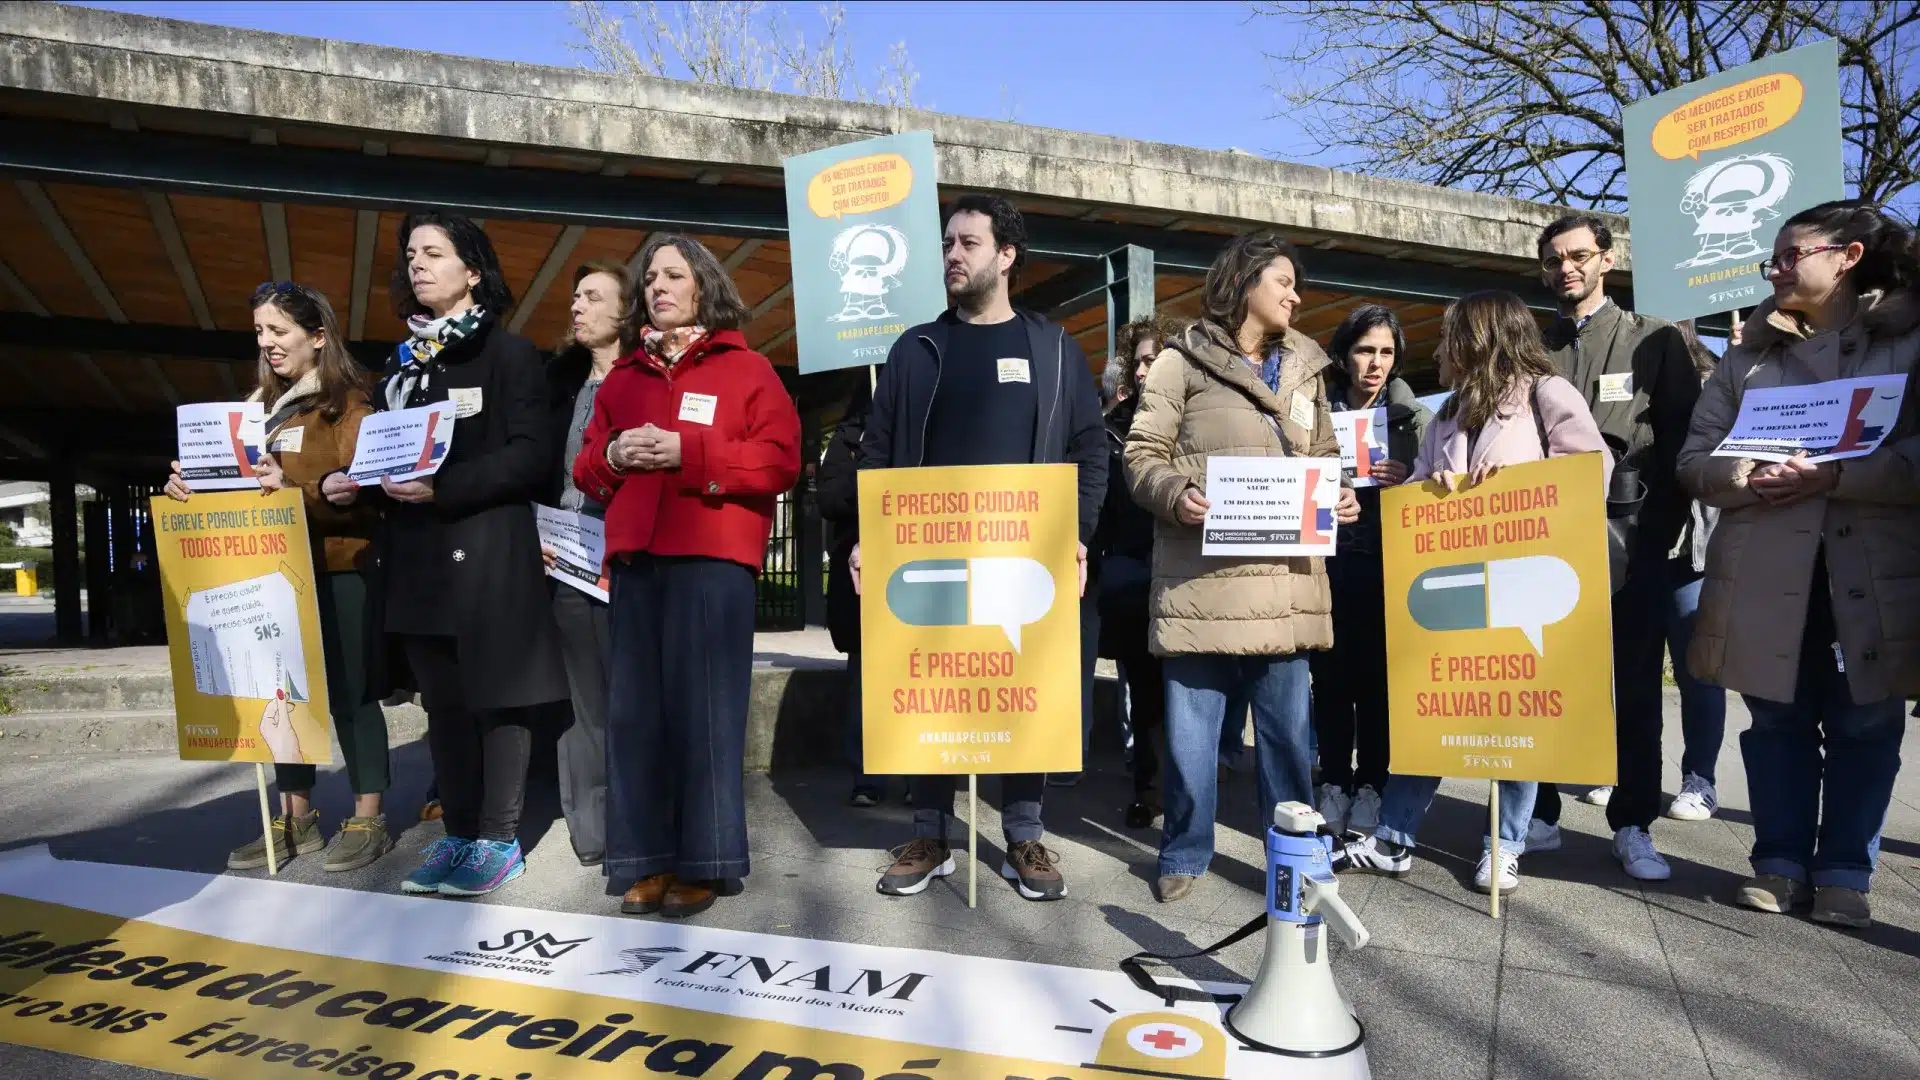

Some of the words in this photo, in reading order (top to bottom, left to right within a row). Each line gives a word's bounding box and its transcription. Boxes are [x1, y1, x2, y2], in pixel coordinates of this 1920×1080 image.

[1673, 110, 1686, 123] OS
[1738, 79, 1780, 103] EXIGEM
[1687, 120, 1706, 134] SER
[1709, 102, 1764, 127] TRATADOS
[1688, 134, 1710, 150] COM
[1713, 117, 1768, 140] RESPEITO!
[822, 173, 831, 183] OS
[867, 160, 896, 173] EXIGEM
[832, 184, 846, 195] SER
[849, 176, 886, 192] TRATADOS
[833, 199, 849, 211] COM
[1688, 262, 1760, 288] #NARUAPELO
[1720, 288, 1755, 301] FNAM
[1771, 403, 1807, 411] DIÁLOGO
[882, 491, 891, 516] É
[897, 492, 969, 515] PRECISO
[975, 491, 1039, 513] CUIDAR
[1402, 504, 1410, 528] É
[1416, 499, 1484, 526] PRECISO
[1489, 484, 1558, 515] CUIDAR
[162, 512, 169, 532] É
[171, 513, 204, 532] GREVE
[207, 510, 248, 529] PORQUE
[252, 506, 259, 526] É
[261, 507, 296, 525] GRAVE
[896, 523, 918, 544] DE
[923, 521, 970, 544] QUEM
[978, 520, 1030, 542] CUIDA
[180, 536, 220, 558] TODOS
[224, 534, 257, 556] PELO
[260, 532, 288, 555] SNS
[1415, 532, 1435, 554] DE
[1440, 525, 1488, 551] QUEM
[1494, 516, 1549, 544] CUIDA
[211, 590, 238, 602] preciso
[240, 583, 262, 596] cuidar
[211, 606, 220, 617] de
[222, 604, 241, 616] quem
[214, 619, 241, 631] preciso
[243, 613, 264, 624] salvar
[910, 648, 921, 678] É
[928, 652, 1014, 678] PRECISO
[1431, 653, 1442, 682] É
[1449, 653, 1536, 681] PRECISO
[894, 688, 970, 714] SALVAR
[978, 688, 990, 713] O
[997, 687, 1037, 713] SNS
[1417, 692, 1491, 716] SALVAR
[1498, 691, 1511, 716] O
[1519, 690, 1562, 716] SNS
[1473, 758, 1512, 768] FNAM
[424, 954, 482, 967] MÉDICOS
[507, 965, 556, 976] NORTE
[450, 950, 520, 963] SINDICATO
[521, 959, 552, 967] DOS
[672, 950, 933, 1002] FNAM
[15, 1001, 64, 1017] o
[654, 977, 730, 994] Federação
[735, 987, 802, 1003] Nacional
[804, 998, 832, 1008] dos
[837, 1001, 905, 1016] Médicos
[49, 1002, 167, 1034] SNS
[196, 970, 336, 1009] da
[315, 990, 734, 1078] carreira
[169, 1017, 246, 1046] É
[184, 1031, 415, 1080] preciso
